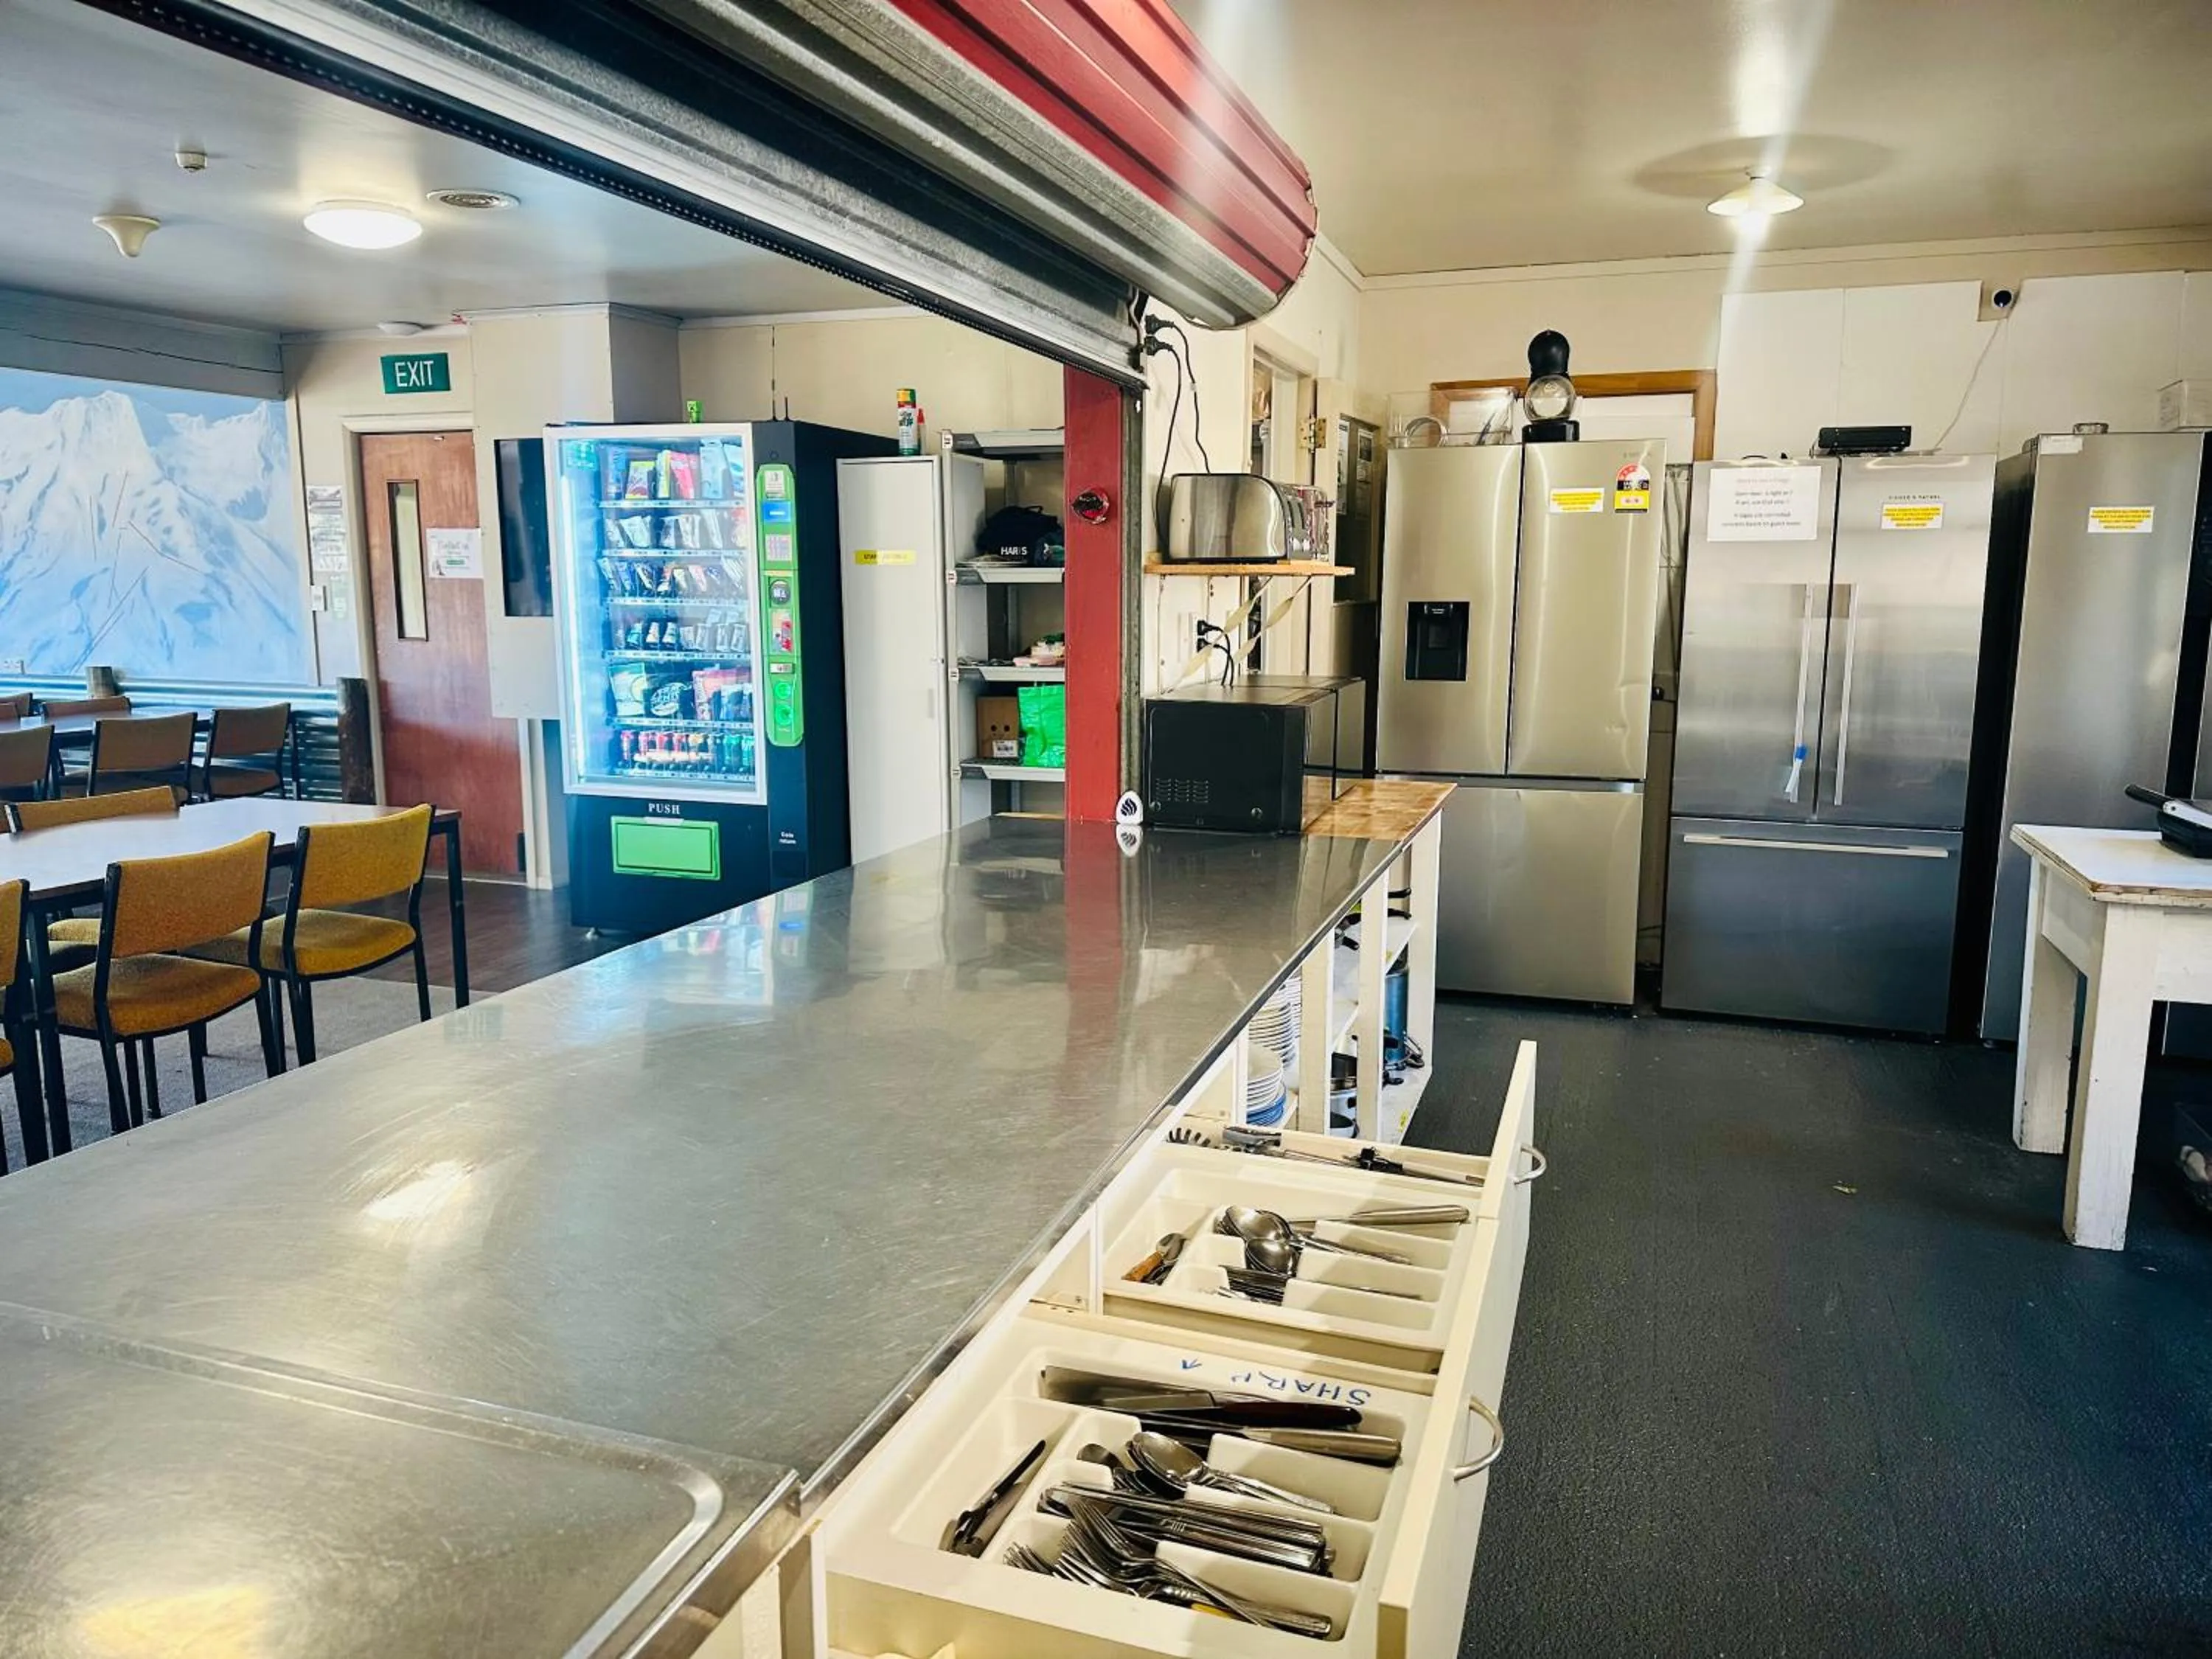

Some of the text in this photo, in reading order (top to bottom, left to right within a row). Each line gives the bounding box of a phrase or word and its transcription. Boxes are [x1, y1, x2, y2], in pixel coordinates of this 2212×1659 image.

[394, 360, 434, 387] EXIT
[648, 803, 681, 815] PUSH
[1231, 1371, 1371, 1406] SHARP
